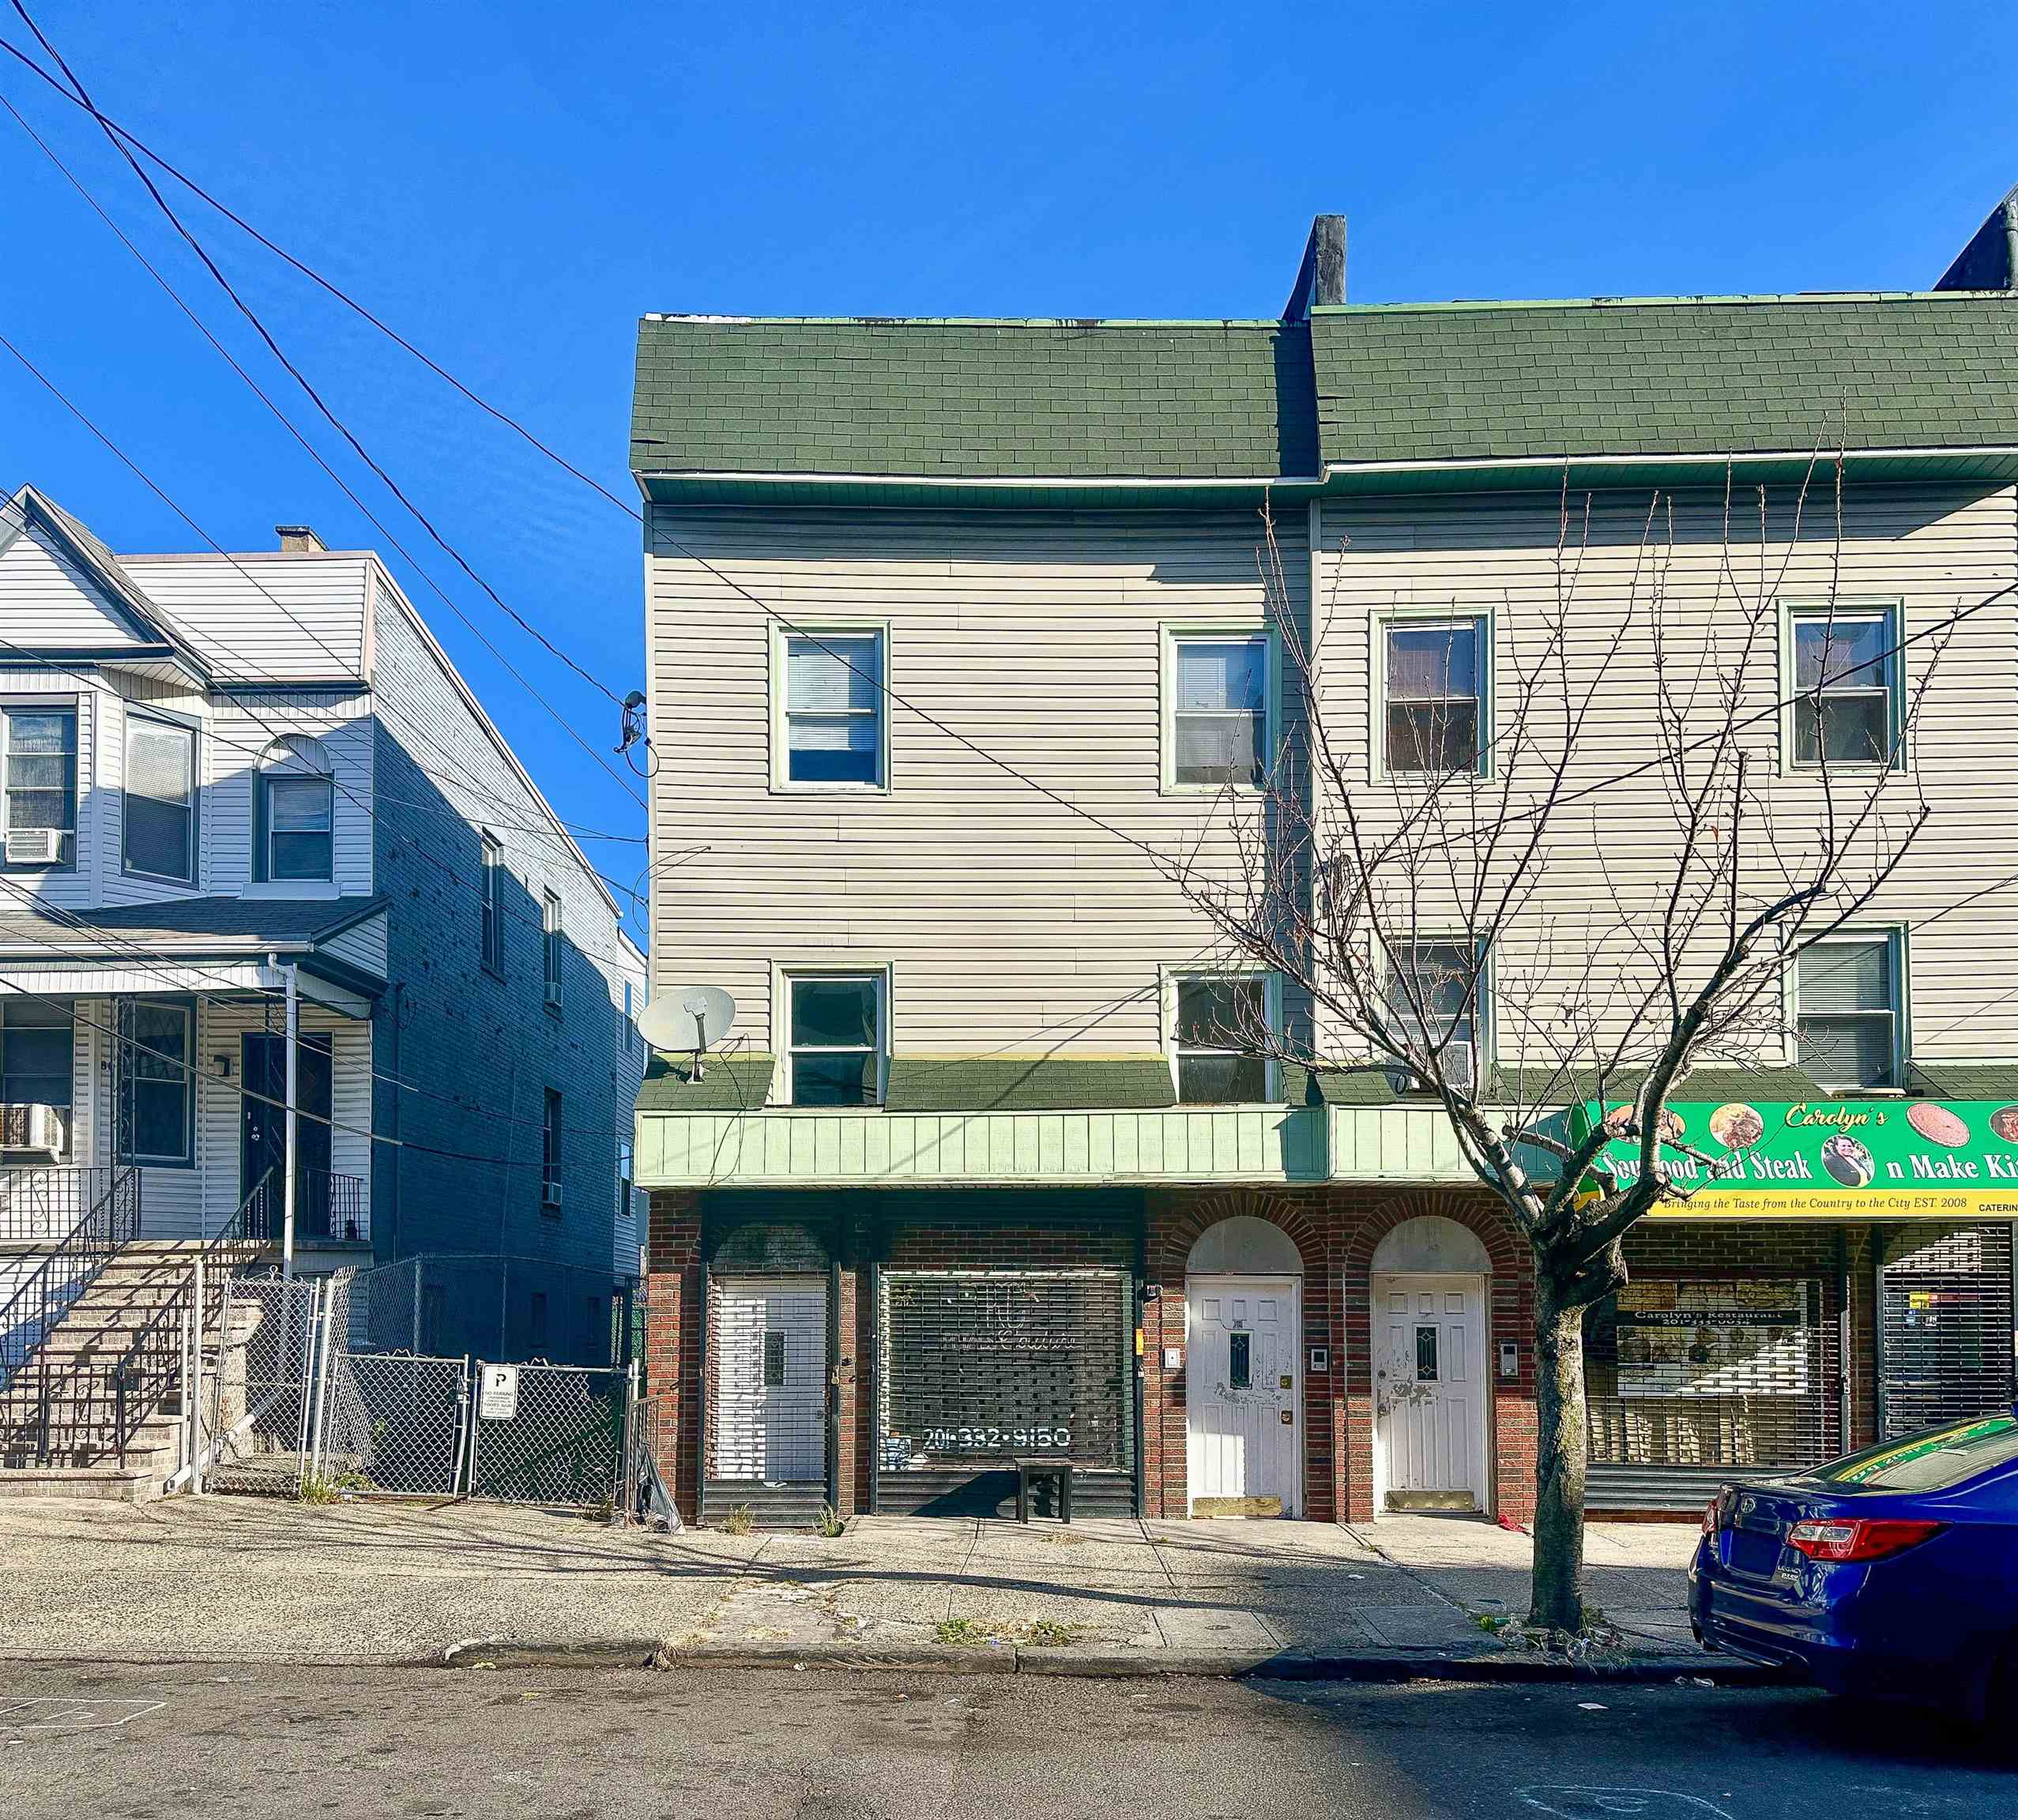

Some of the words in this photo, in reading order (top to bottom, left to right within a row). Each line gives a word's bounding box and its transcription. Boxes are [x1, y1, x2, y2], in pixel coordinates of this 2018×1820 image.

[1785, 1100, 1888, 1133] Carolyn's
[1603, 1151, 1643, 1180] Sou
[1655, 1153, 1700, 1180] ood
[1752, 1150, 1813, 1180] Steak
[1885, 1160, 1905, 1179] n
[1908, 1153, 1979, 1179] Make
[1664, 1199, 1711, 1210] Bringing
[1714, 1198, 1730, 1209] the
[1733, 1198, 1760, 1209] Taste
[1762, 1198, 1787, 1210] from
[1790, 1198, 1806, 1209] the
[1809, 1198, 1853, 1209] Country
[1867, 1198, 1884, 1209] the
[1888, 1198, 1911, 1209] City
[1941, 1198, 1967, 1209] 2008
[1634, 1311, 1702, 1320] Carolyn's
